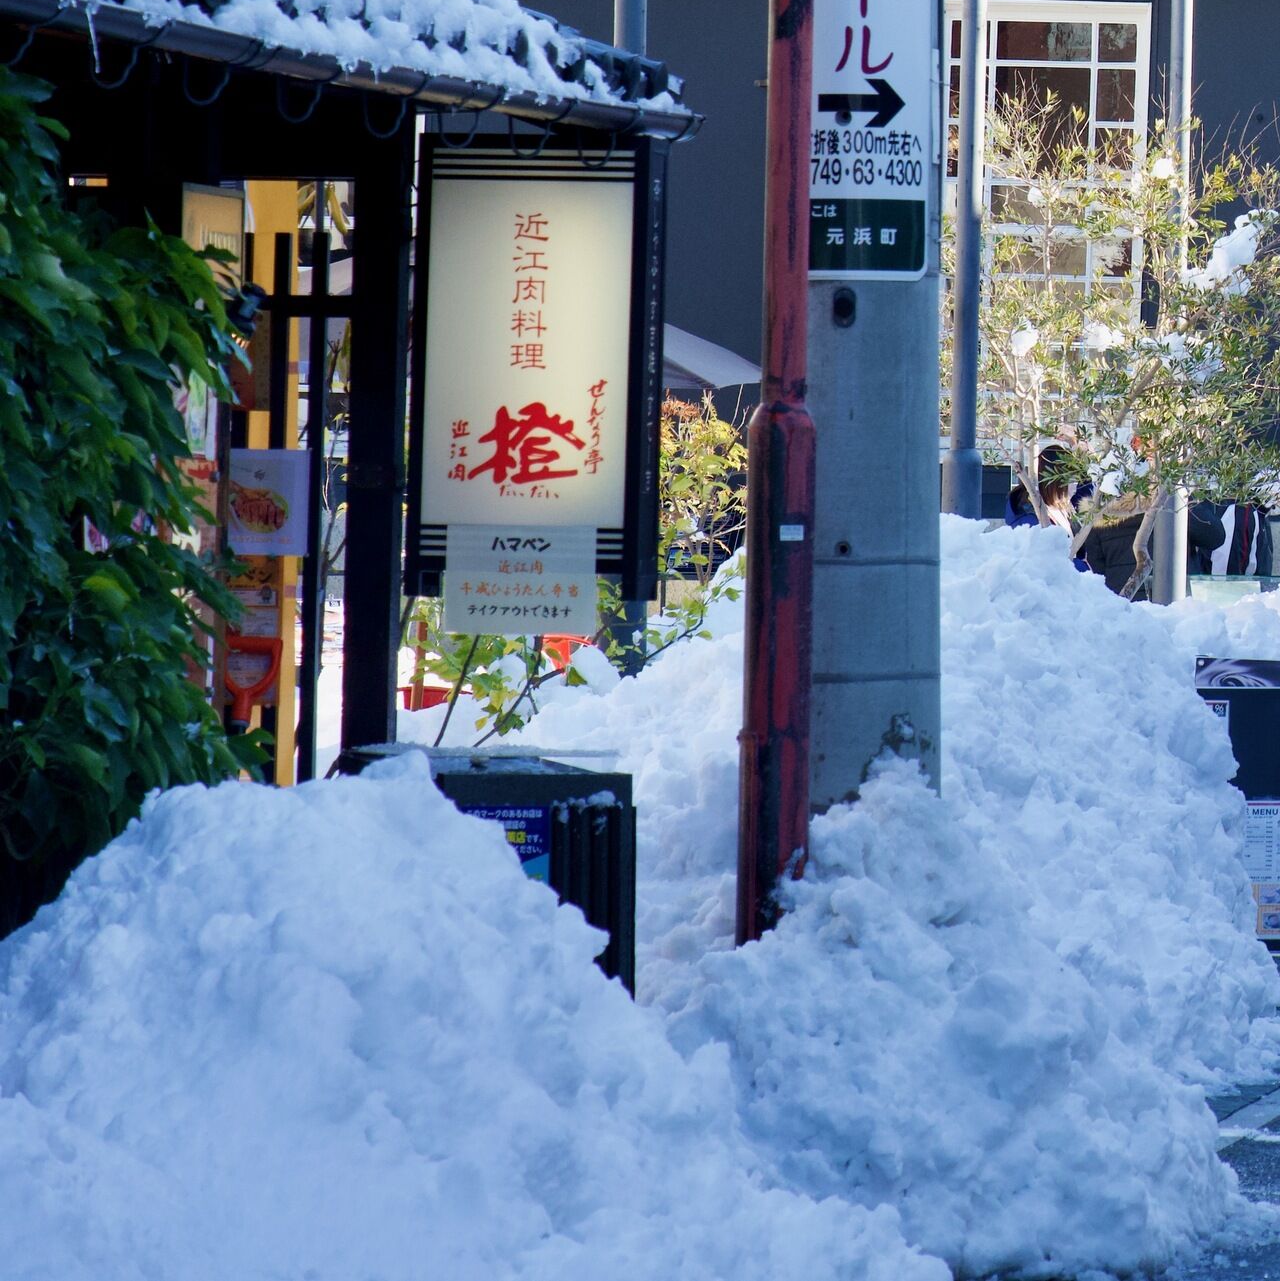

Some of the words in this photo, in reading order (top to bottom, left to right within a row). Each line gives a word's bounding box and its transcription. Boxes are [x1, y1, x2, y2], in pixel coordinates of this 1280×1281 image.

[811, 129, 922, 156] 折後300m先右へ
[510, 212, 549, 371] 近江肉料理
[584, 380, 608, 474] せんなり亭
[448, 419, 470, 481] 近江肉
[467, 402, 587, 484] 橙
[492, 537, 552, 553] ハマベン
[498, 560, 544, 575] 近江肉
[467, 605, 572, 619] テイクアウトできます
[1252, 808, 1279, 816] MENU
